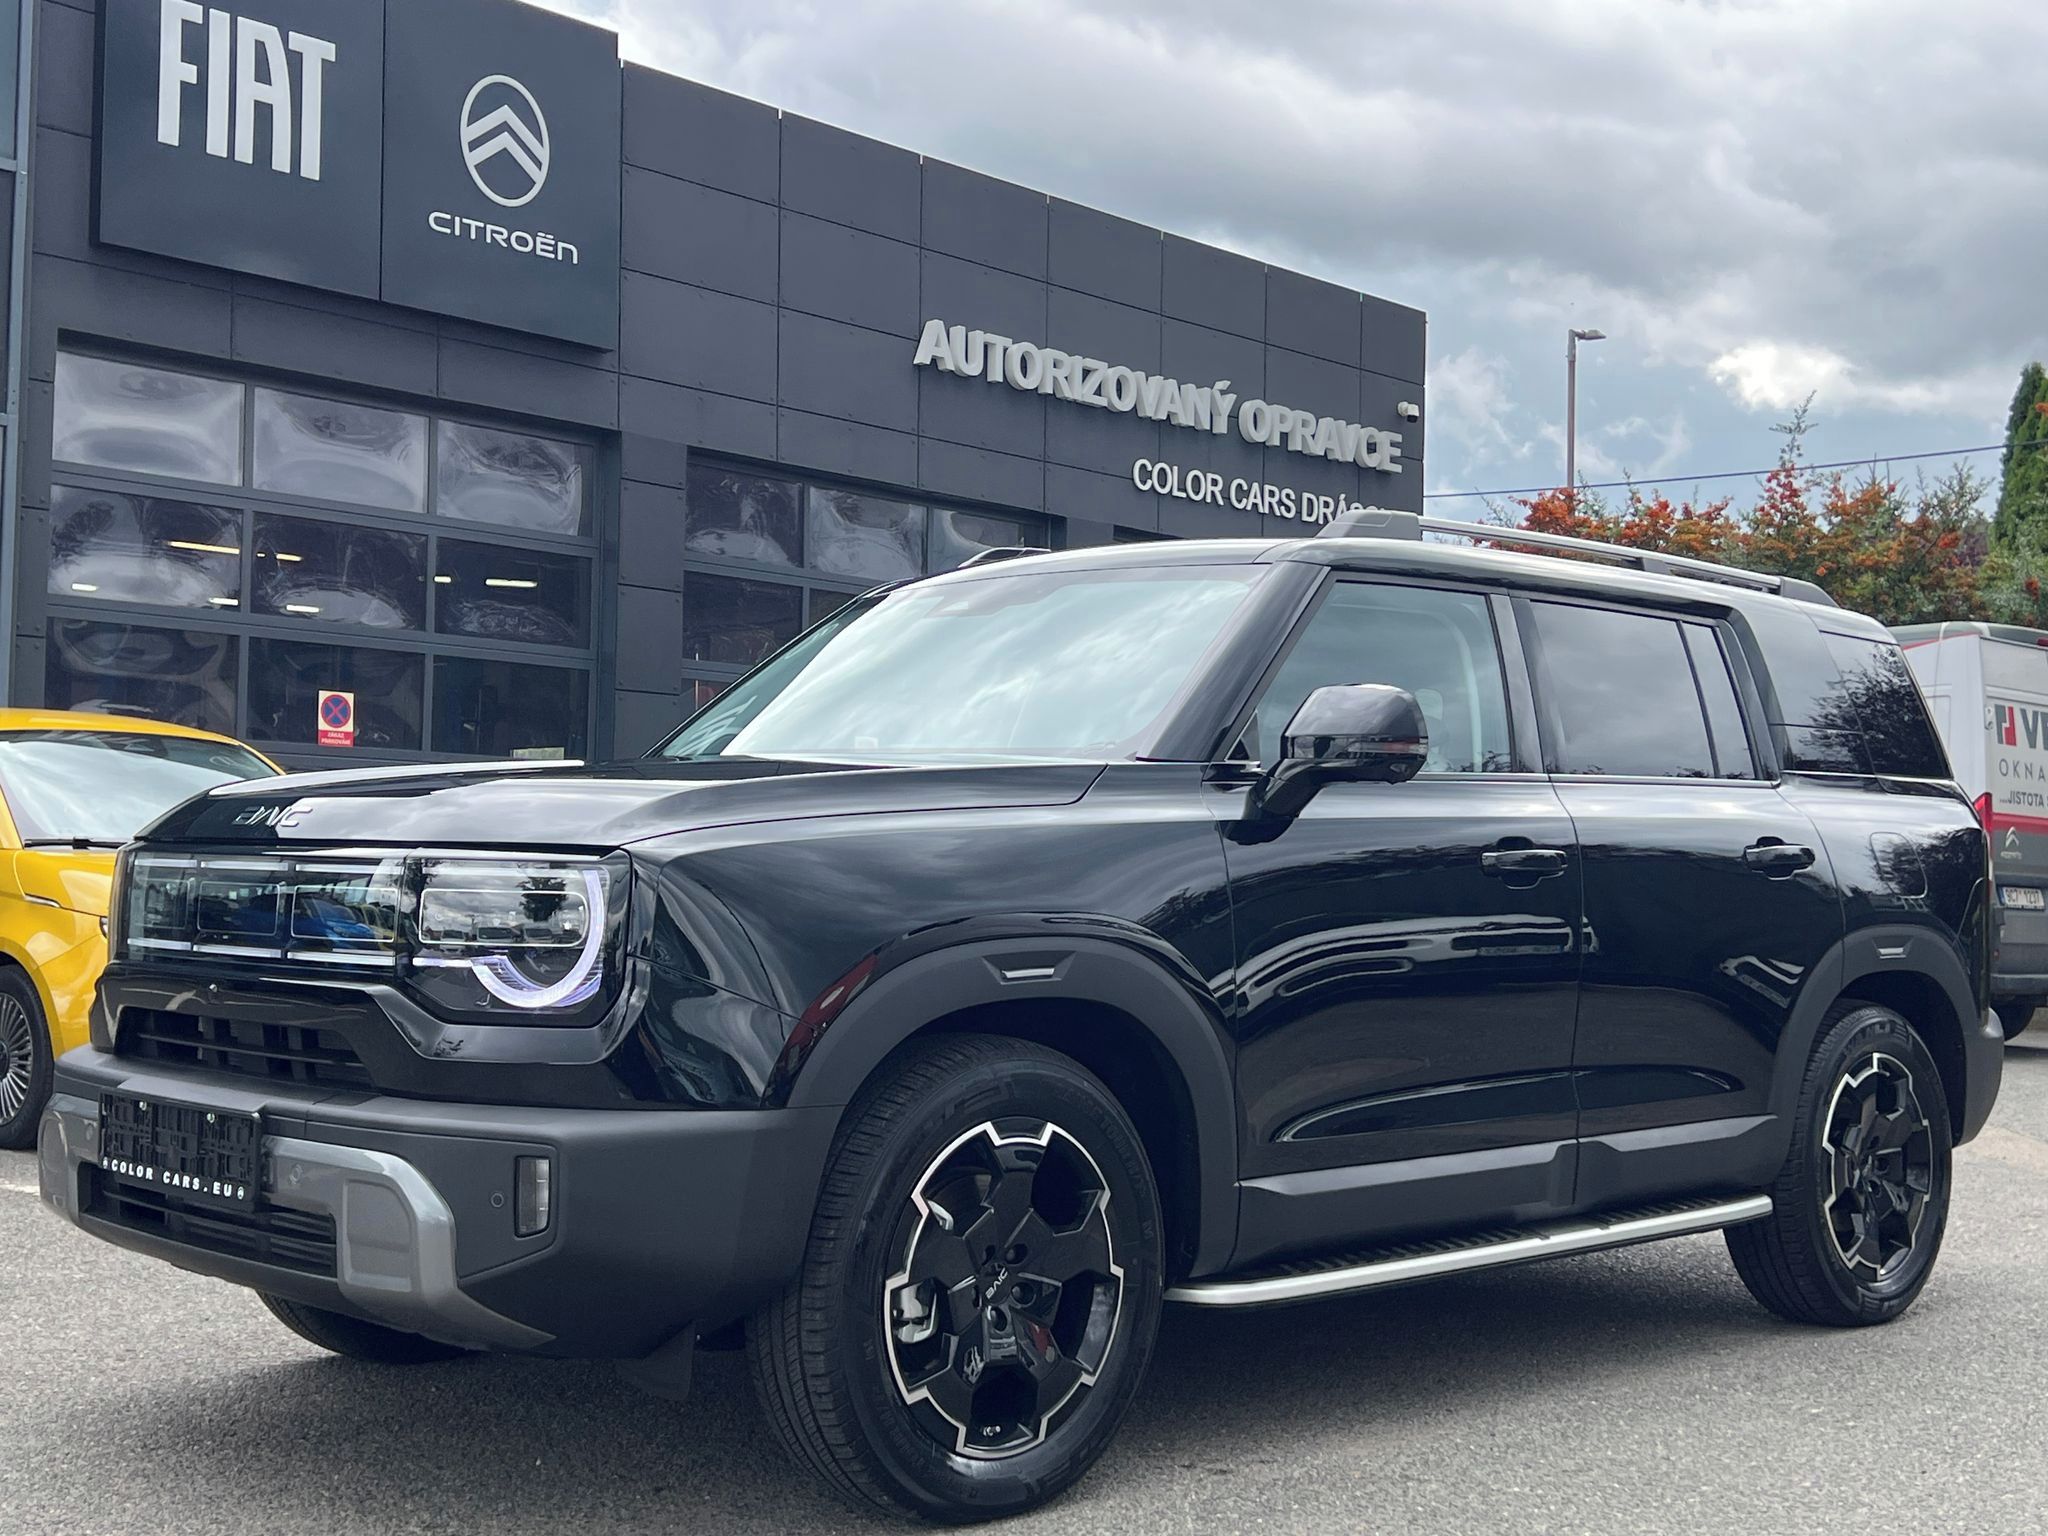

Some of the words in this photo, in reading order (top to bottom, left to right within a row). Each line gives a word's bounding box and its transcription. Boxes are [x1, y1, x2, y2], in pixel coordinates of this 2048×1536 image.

[157, 0, 336, 181] FIAT
[428, 210, 578, 264] CITROËN
[913, 319, 1237, 434] AUTORIZOVANÝ
[1238, 398, 1403, 473] OPRAVCE
[1132, 458, 1224, 506] COLOR
[1229, 477, 1297, 519] CARS
[1301, 491, 1386, 525] DRÁ
[111, 1158, 153, 1180] COLOR
